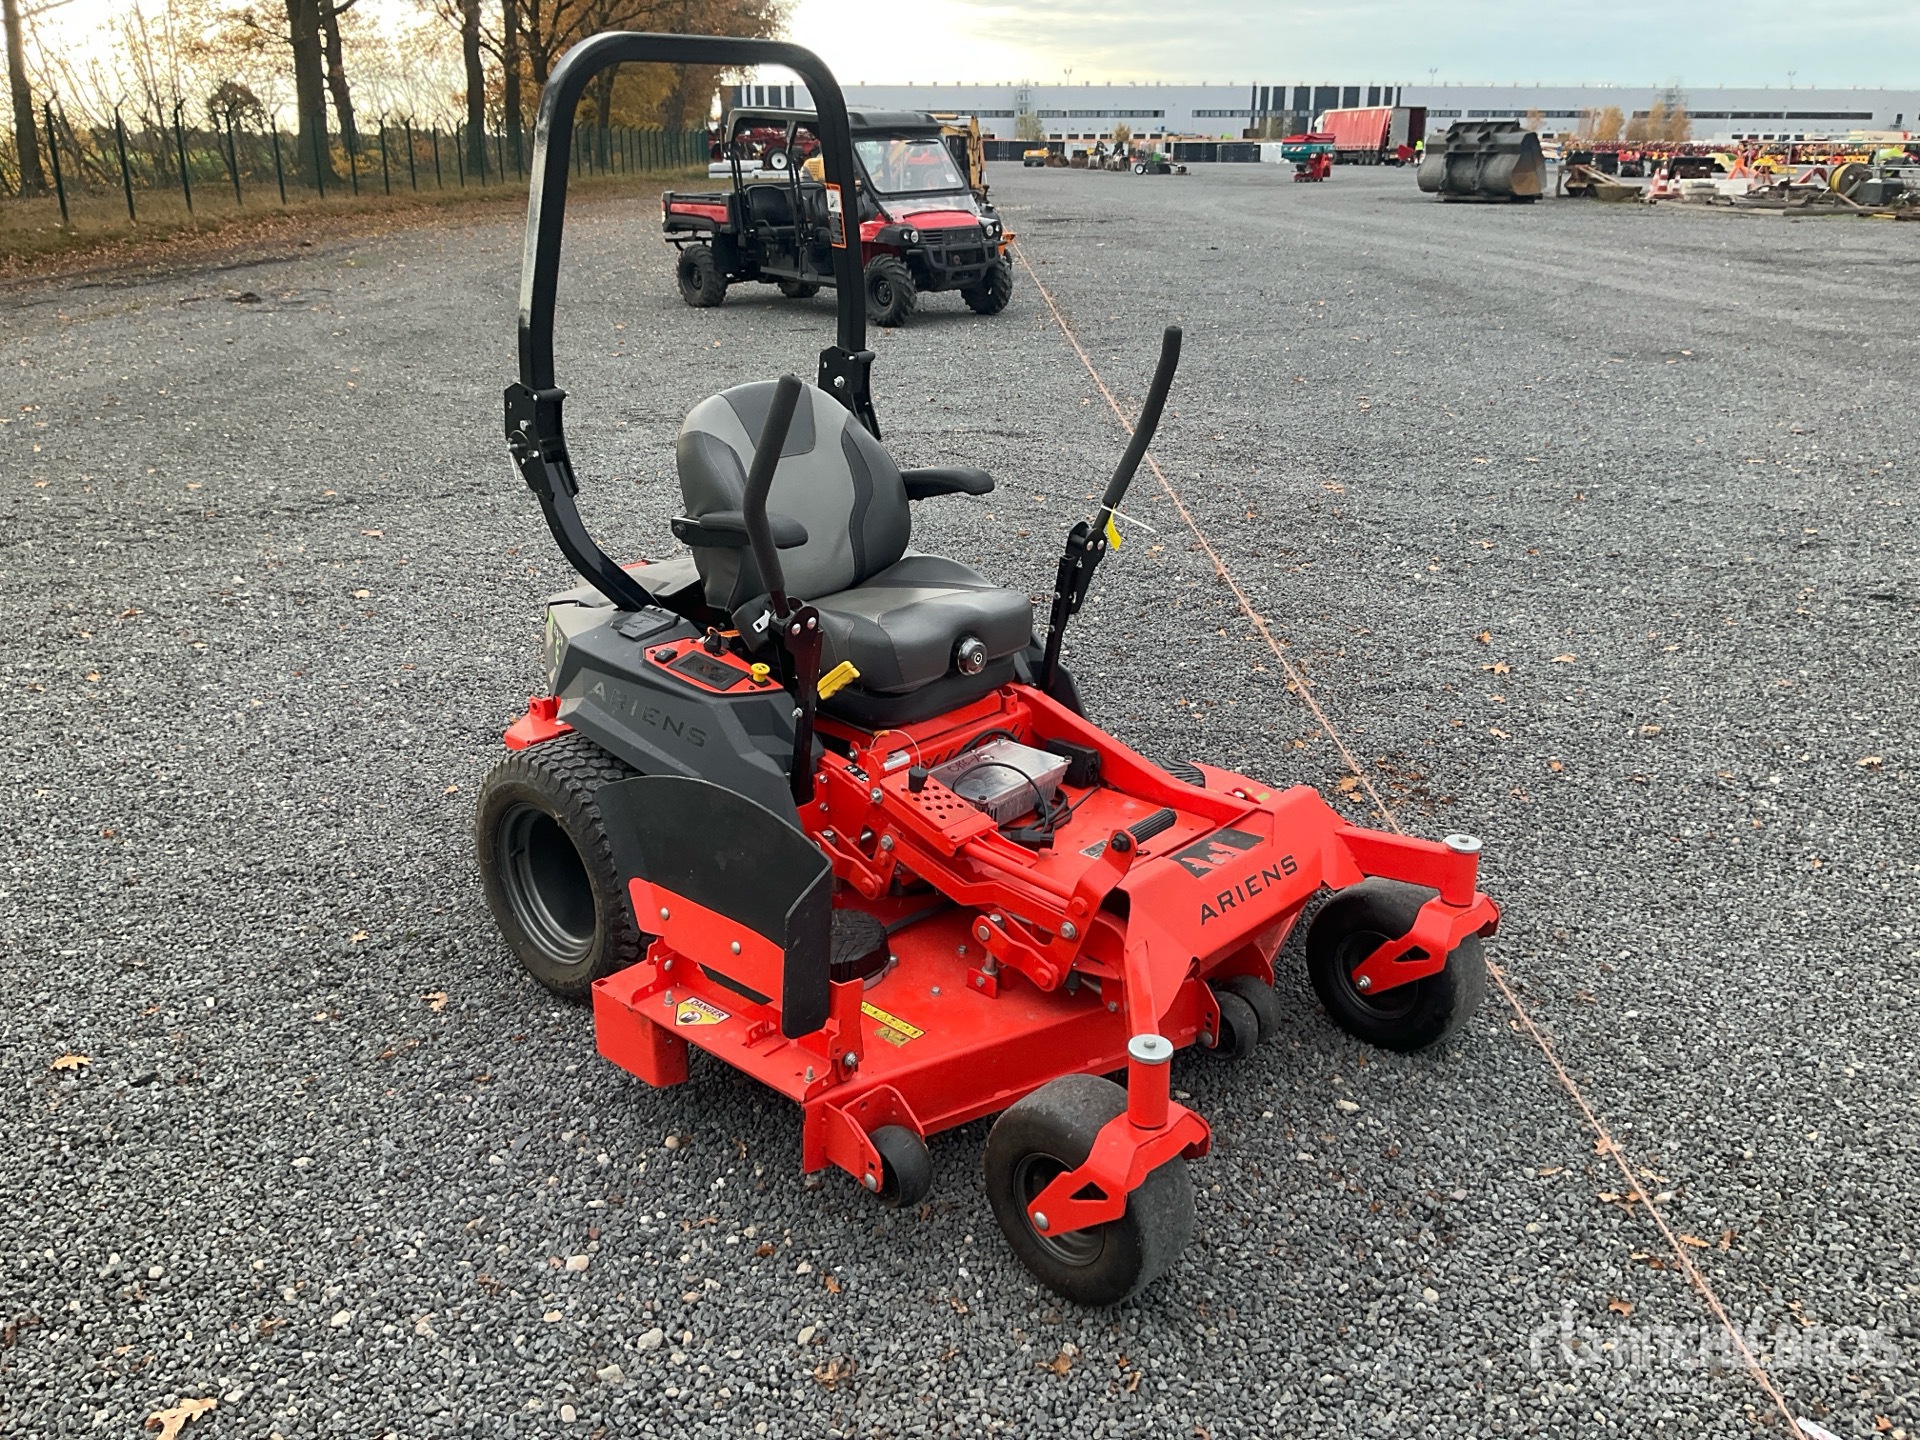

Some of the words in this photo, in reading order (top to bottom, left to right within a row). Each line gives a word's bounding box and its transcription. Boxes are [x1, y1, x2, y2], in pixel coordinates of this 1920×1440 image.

[588, 681, 707, 747] ARIENS
[1201, 854, 1298, 926] ARIENS
[691, 1000, 724, 1019] DANGER
